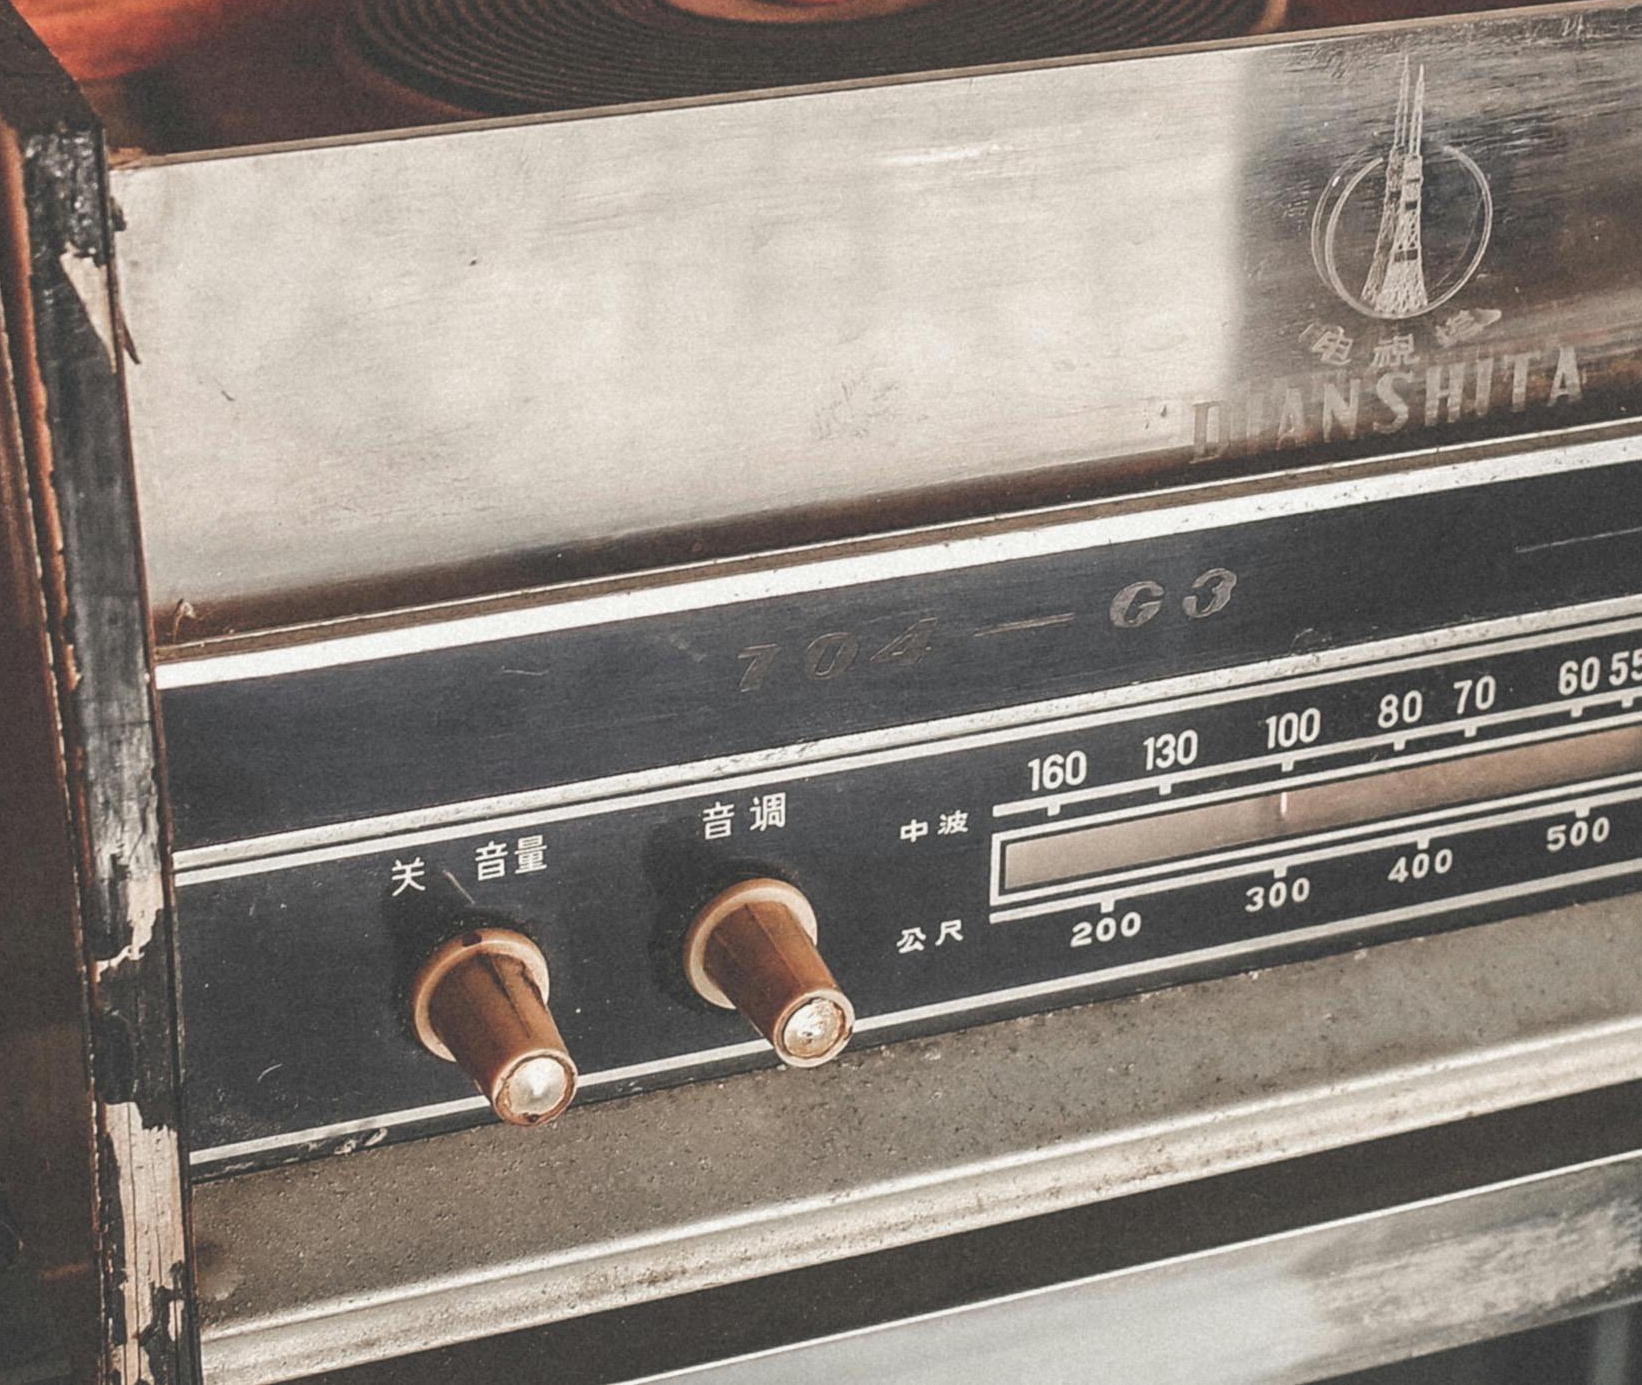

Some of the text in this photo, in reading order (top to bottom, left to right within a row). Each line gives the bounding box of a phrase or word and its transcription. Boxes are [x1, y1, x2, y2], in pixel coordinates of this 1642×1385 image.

[1027, 750, 1087, 791] 160
[1142, 730, 1198, 771] 130
[1264, 707, 1321, 749] 100
[1377, 690, 1423, 729] 80
[1453, 675, 1496, 715] 70
[1558, 656, 1601, 696] 60
[702, 792, 787, 840] 音调
[900, 810, 969, 843] 中波
[391, 835, 548, 897] 关 音量
[1070, 817, 1610, 949] 200 300 400 500
[896, 919, 964, 954] 公尺
